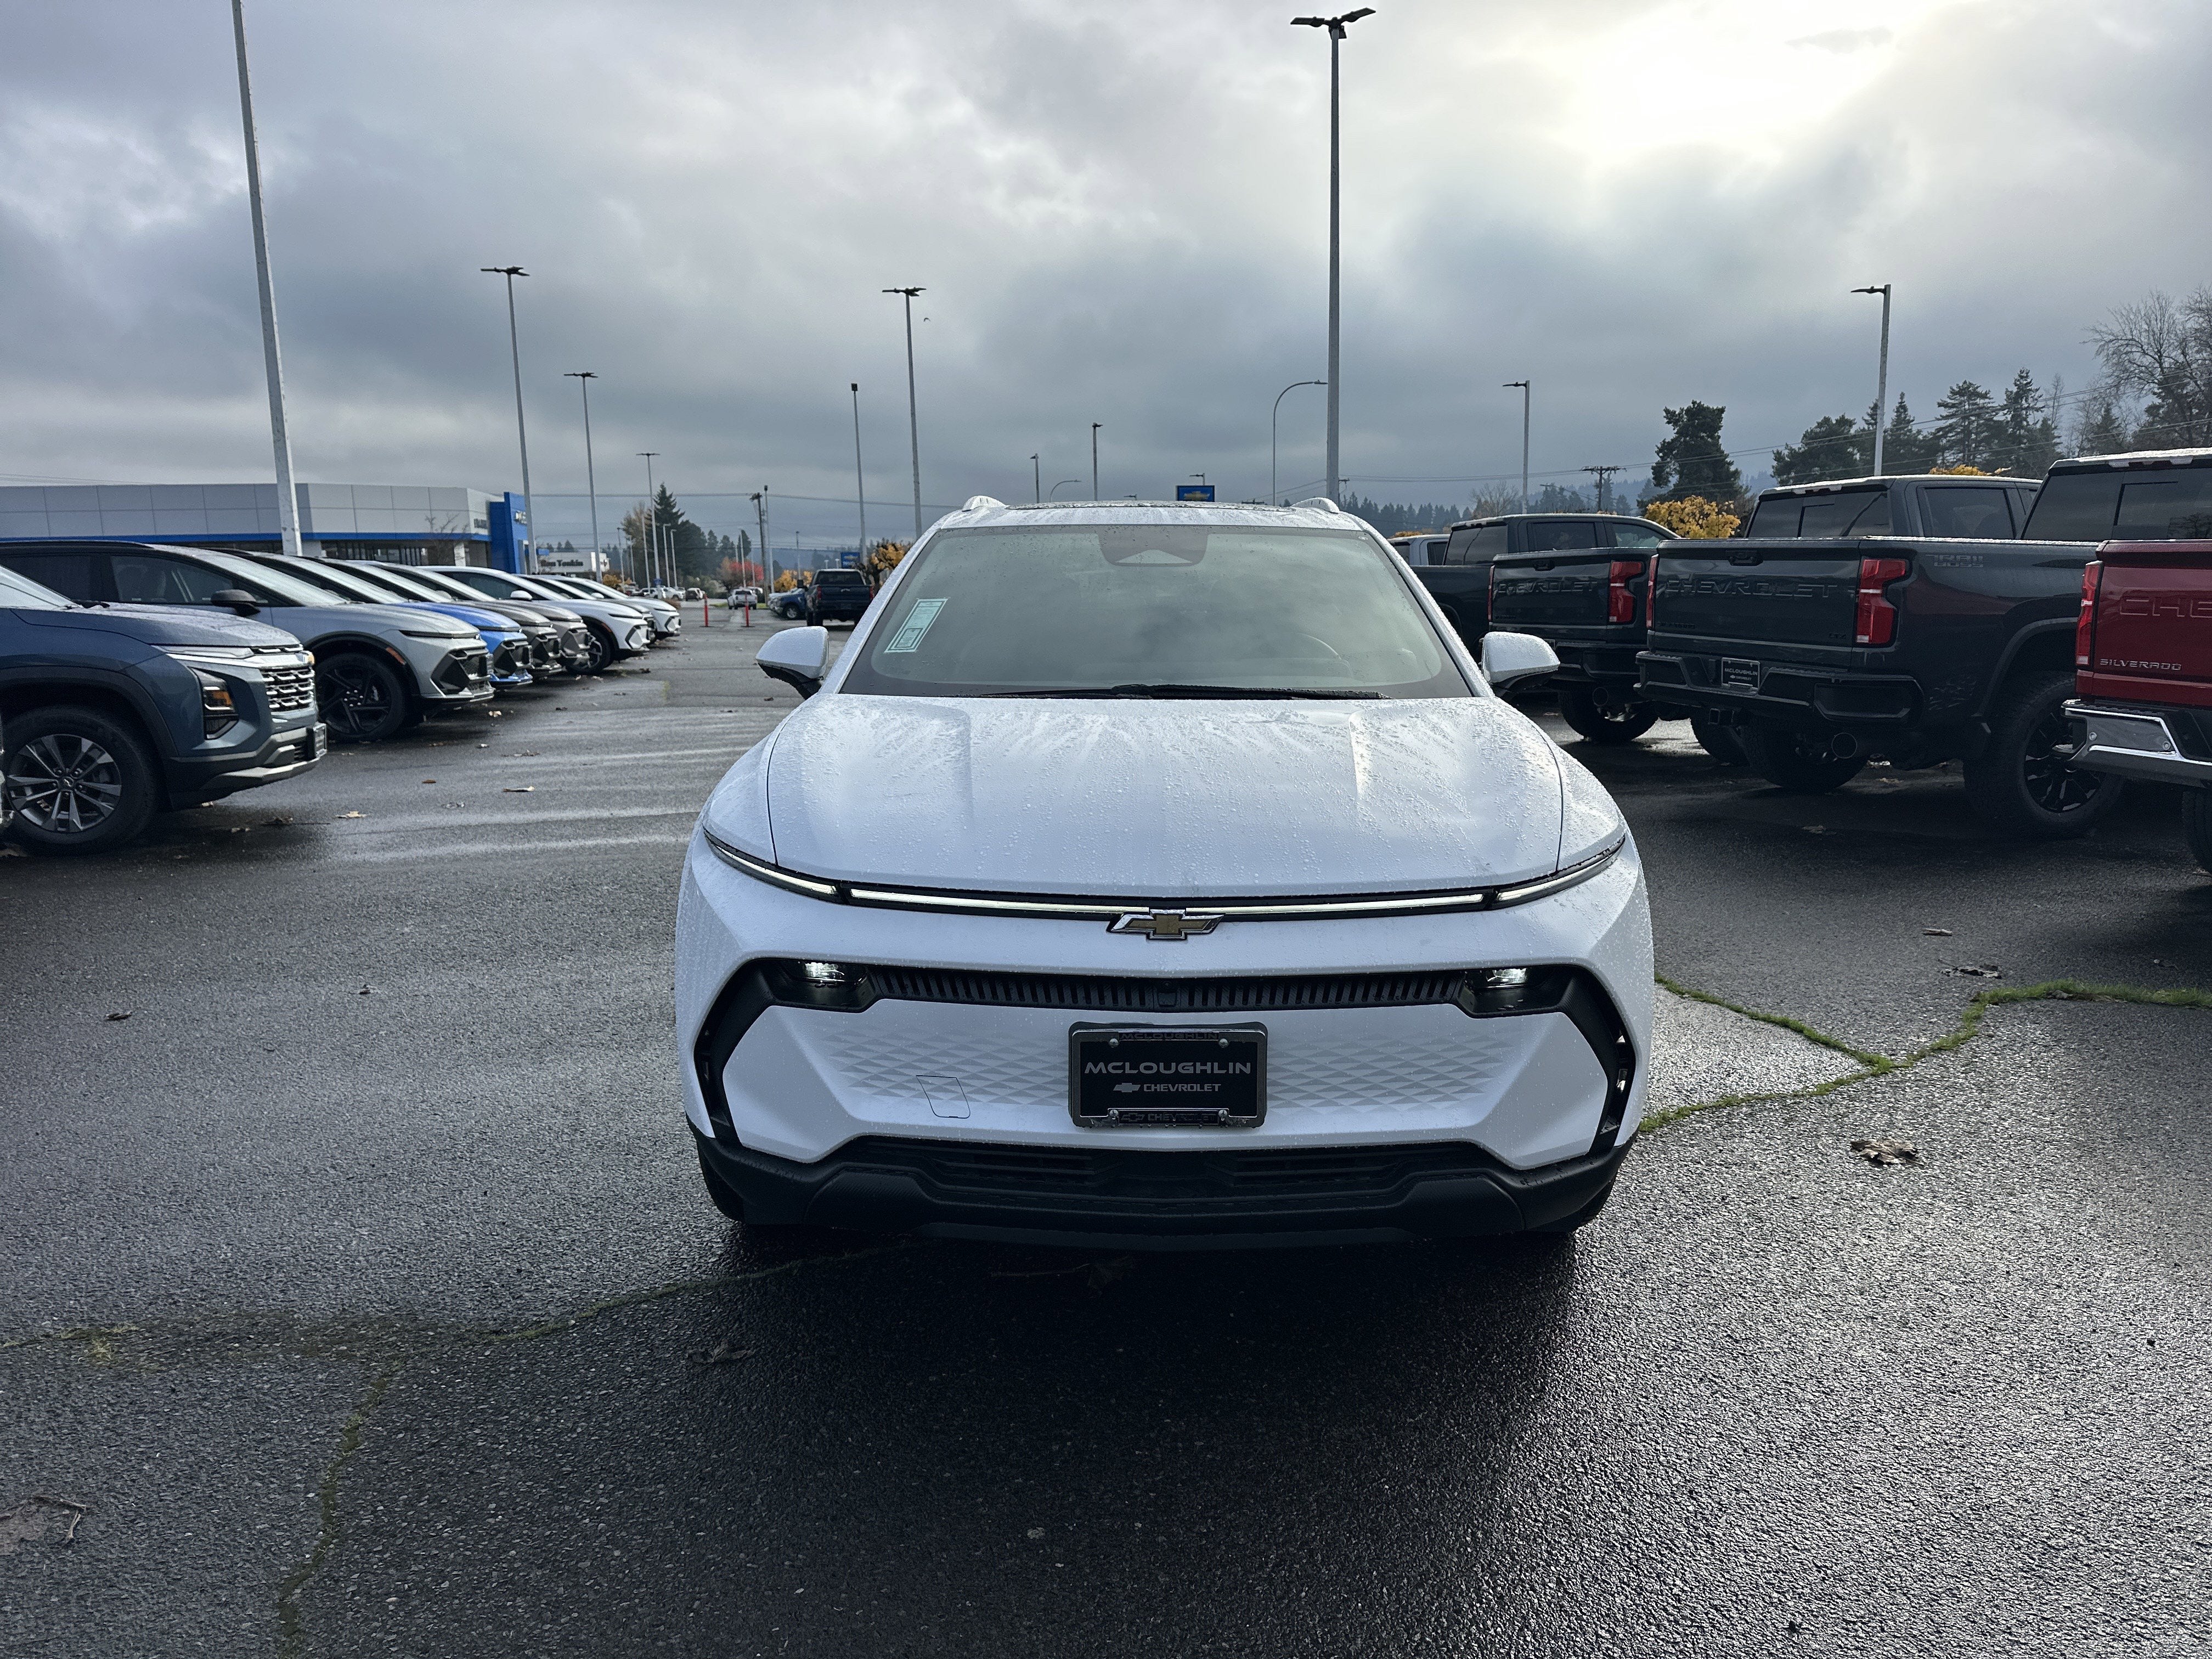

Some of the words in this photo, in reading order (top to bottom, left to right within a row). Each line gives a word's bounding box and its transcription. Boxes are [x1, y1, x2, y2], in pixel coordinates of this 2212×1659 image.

[1664, 579, 1838, 598] CHEVROLET
[2100, 658, 2182, 670] SILVERADO
[1084, 1062, 1251, 1074] MCLOUGHLIN
[1143, 1084, 1222, 1092] CHEVROLET
[1147, 1113, 1217, 1121] CHEVROLET
